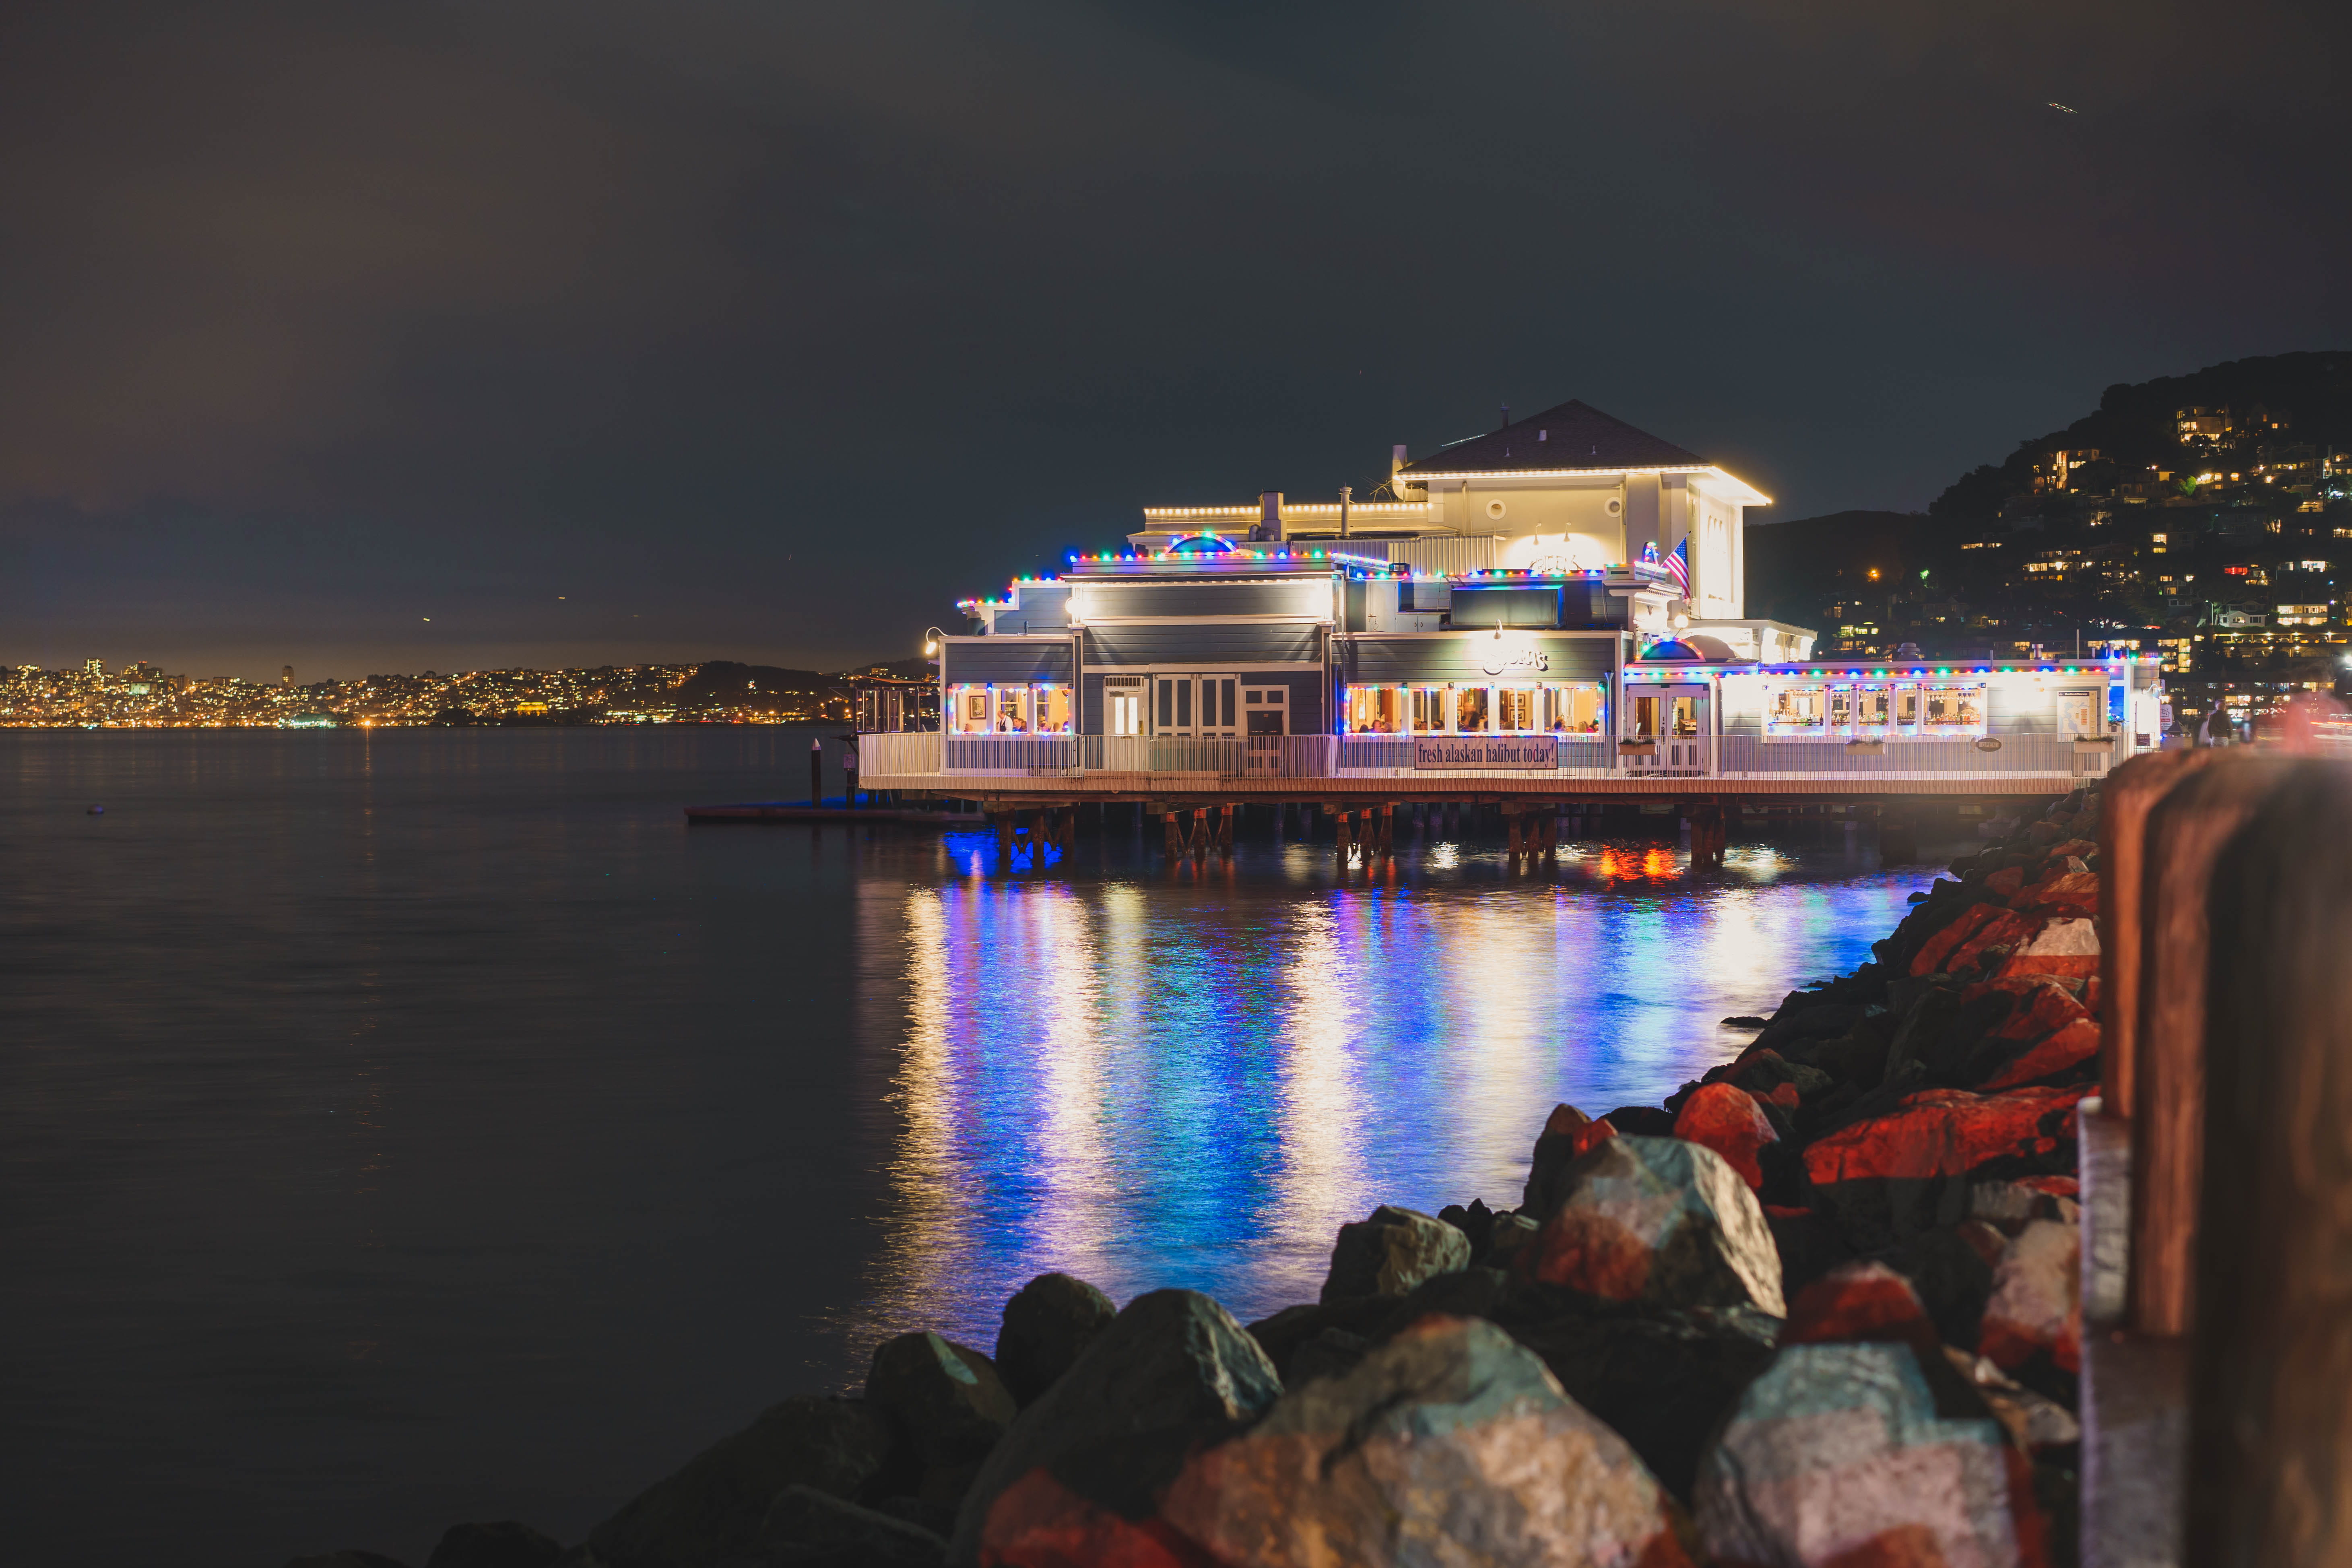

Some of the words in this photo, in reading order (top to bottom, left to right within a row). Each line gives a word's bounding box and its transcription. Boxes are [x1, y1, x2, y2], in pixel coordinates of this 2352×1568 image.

[1419, 744, 1442, 763] fresh
[1446, 744, 1483, 763] alaskan
[1486, 743, 1520, 763] halibut
[1523, 743, 1554, 767] today!
